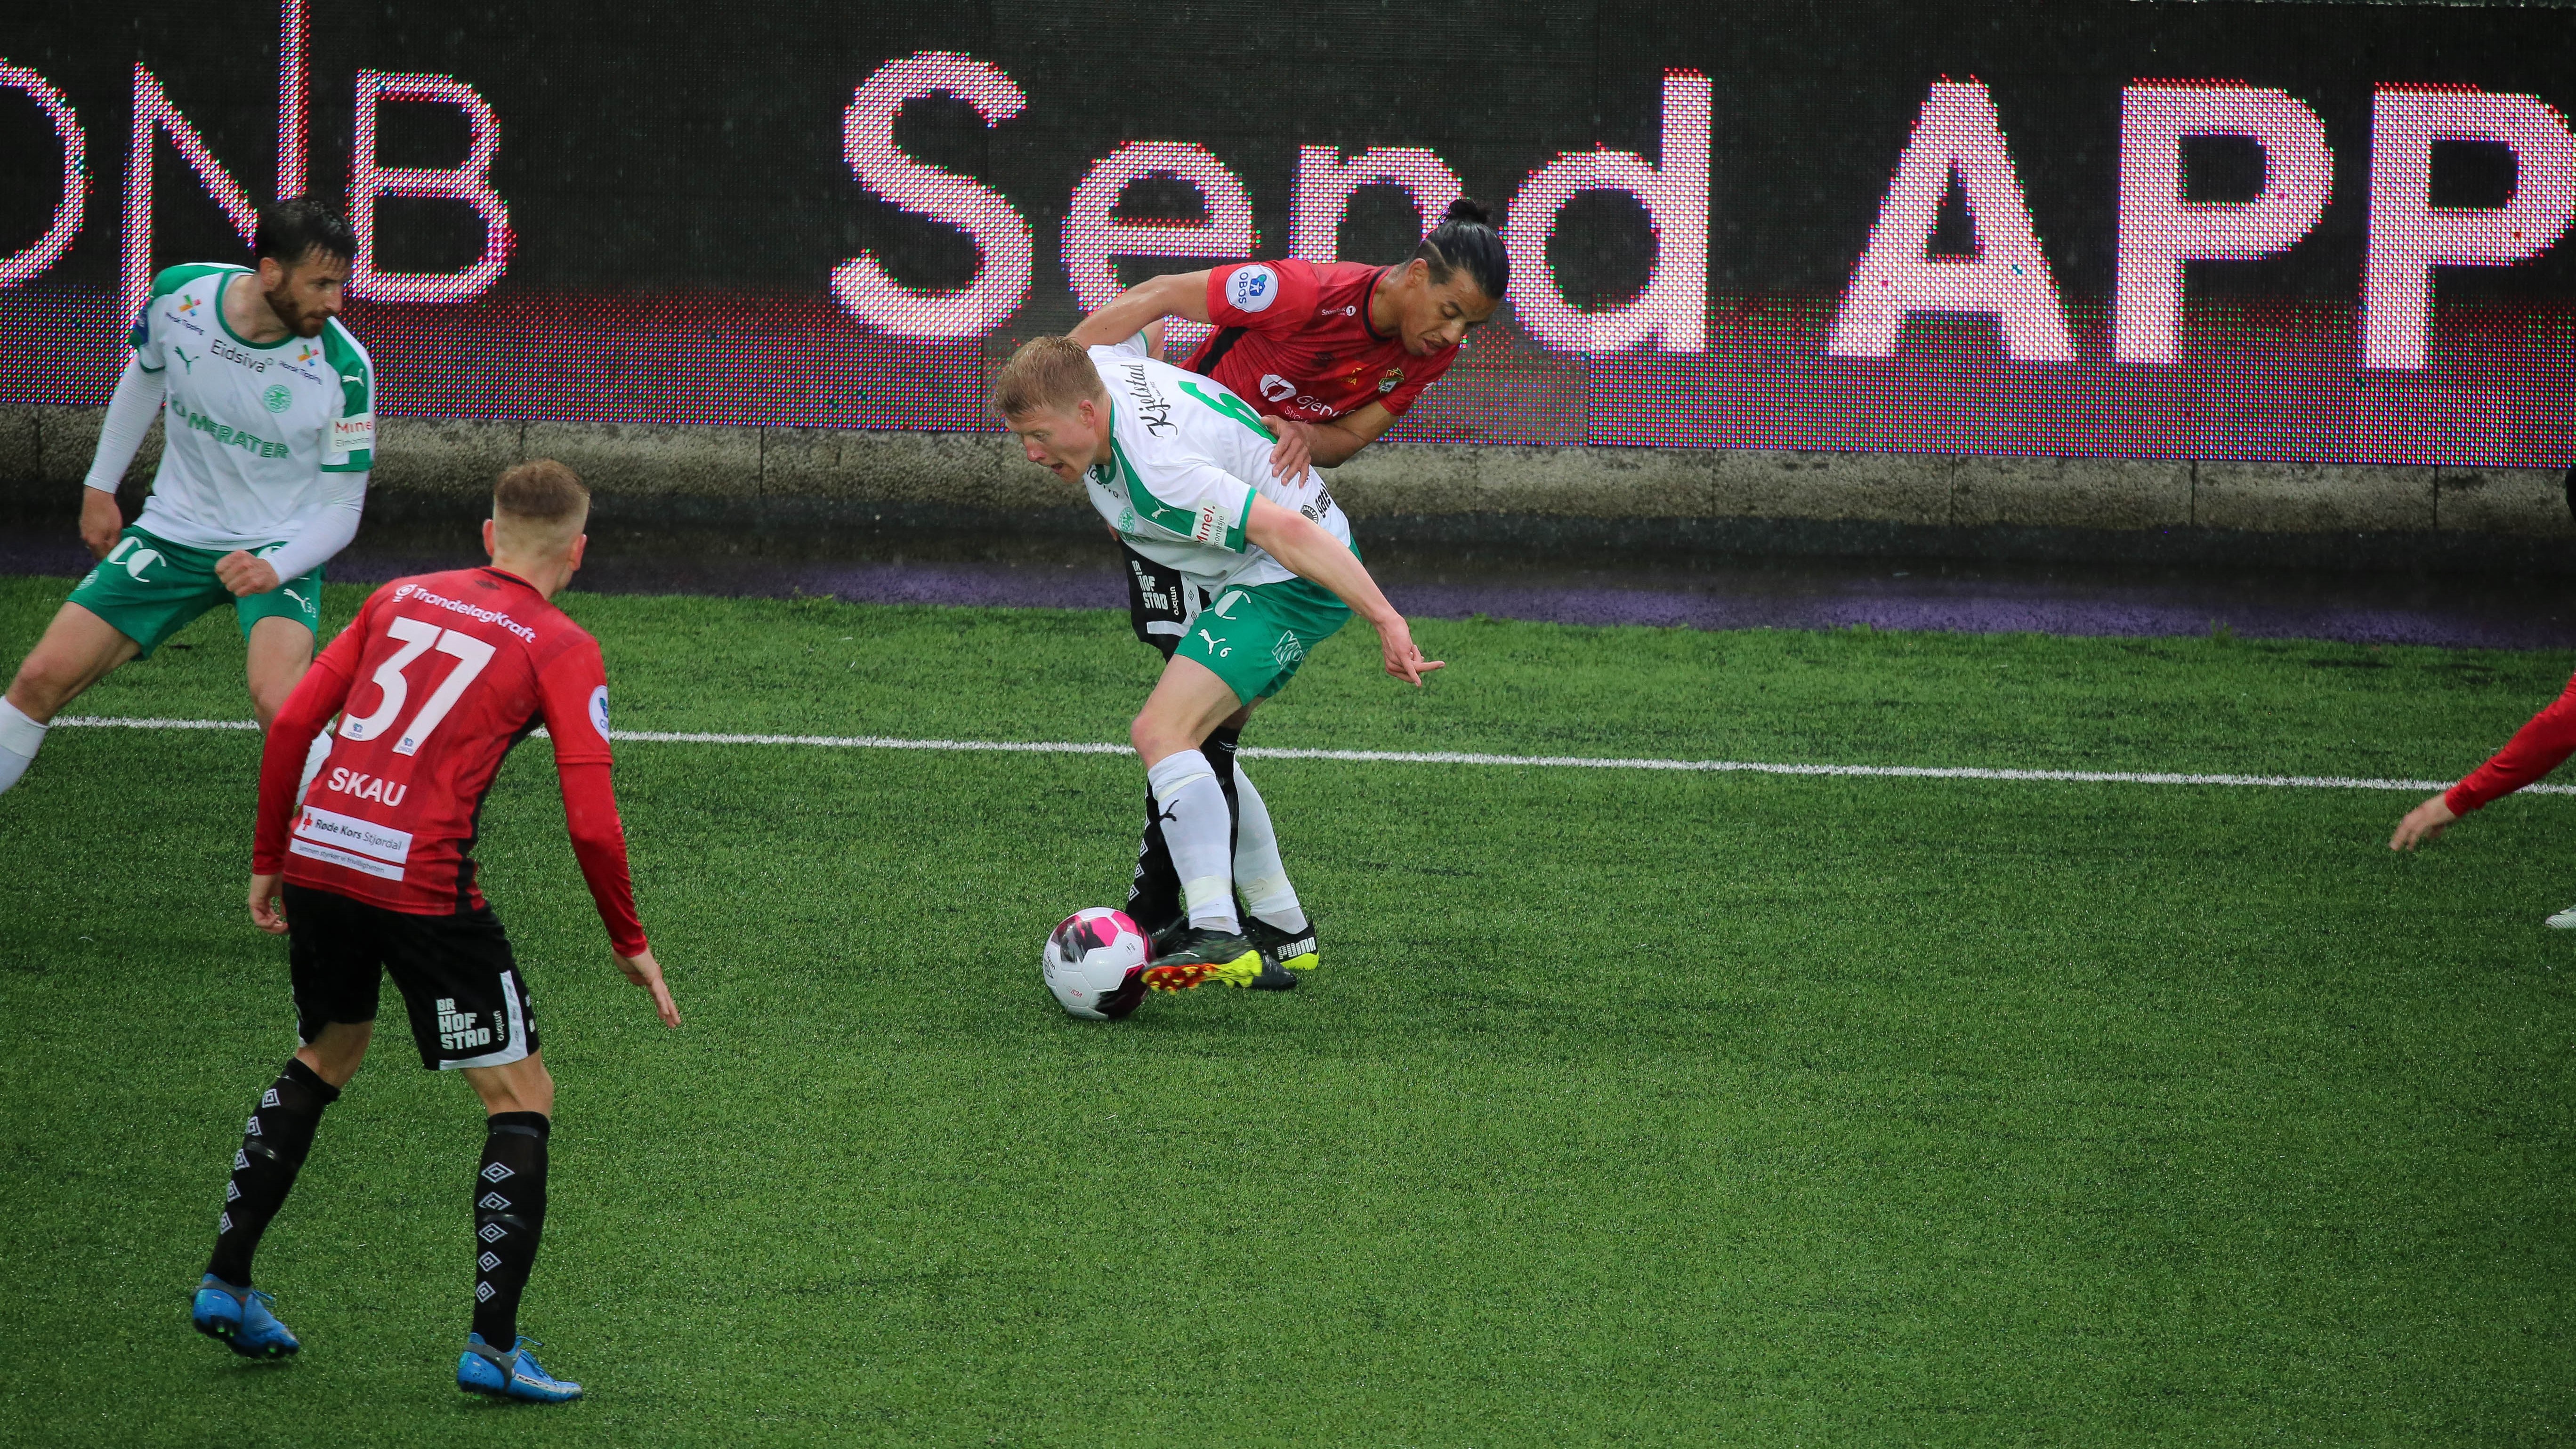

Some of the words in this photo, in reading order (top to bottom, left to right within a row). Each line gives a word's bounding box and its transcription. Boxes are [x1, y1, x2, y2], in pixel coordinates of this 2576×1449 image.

[831, 51, 1713, 352] Send
[1827, 74, 2576, 369] APP
[1238, 272, 1249, 304] OBOS
[210, 338, 266, 373] Eidsiva
[1121, 364, 1178, 438] Kjelstad
[335, 421, 372, 434] Mine
[1137, 575, 1155, 592] HOF
[1142, 592, 1169, 610] STAD
[1170, 586, 1179, 616] umbro
[1219, 647, 1232, 658] 6
[339, 616, 497, 757] 37
[328, 767, 407, 807] SKAU
[315, 819, 339, 833] Røde
[340, 826, 362, 839] Kors
[363, 832, 402, 850] Stjørdal
[1276, 936, 1317, 959] PUMA
[436, 998, 456, 1012] BR
[437, 1013, 477, 1033] HOF
[493, 1010, 505, 1042] umbro
[440, 1027, 491, 1050] STAD
